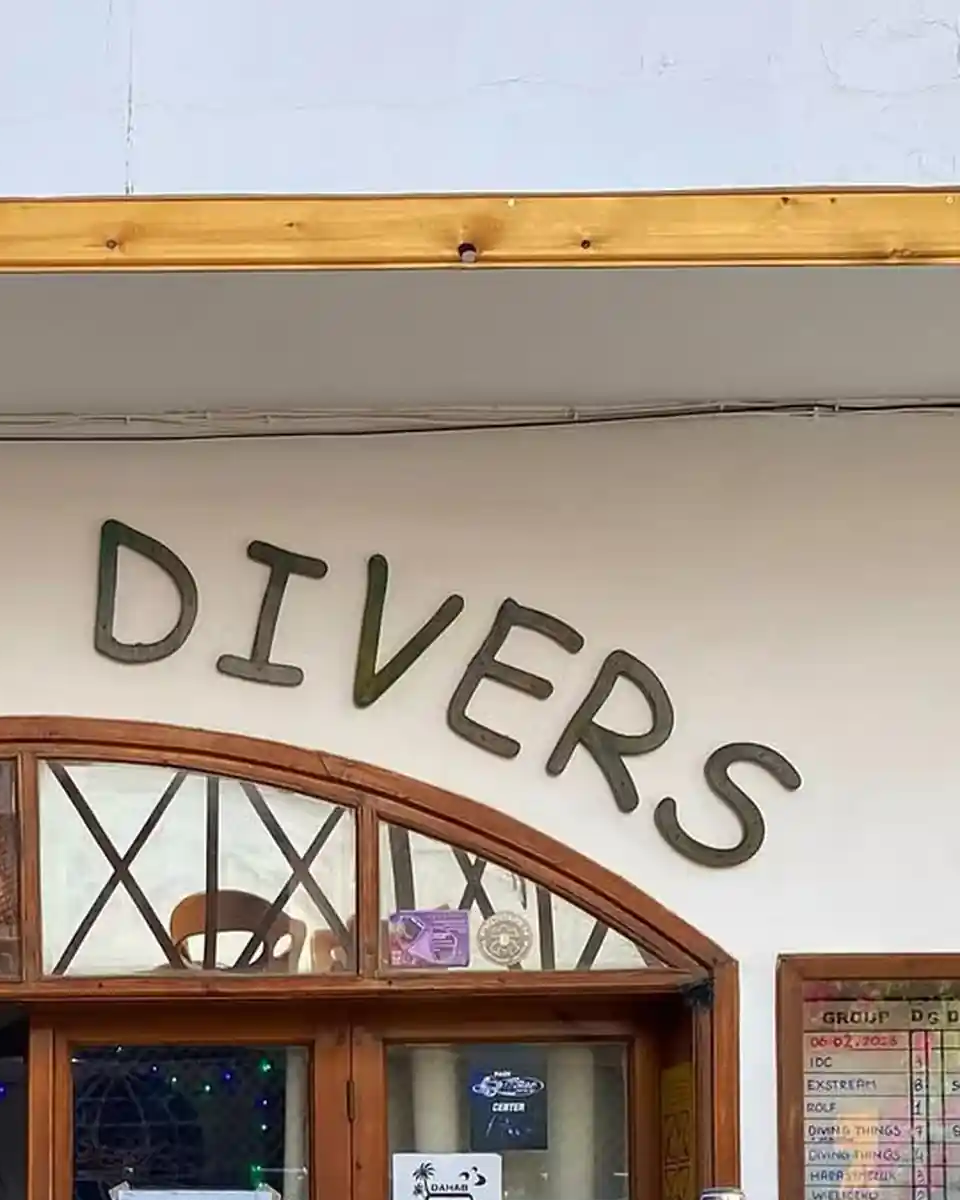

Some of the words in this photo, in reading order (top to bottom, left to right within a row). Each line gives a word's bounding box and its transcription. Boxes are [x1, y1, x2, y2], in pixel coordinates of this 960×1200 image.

[92, 519, 802, 869] DIVERS
[822, 1011, 890, 1025] GROUP
[810, 1056, 833, 1068] IDC
[807, 1079, 877, 1092] EXSTREAM
[808, 1127, 851, 1137] DIVING
[854, 1125, 902, 1137] THINGS
[852, 1150, 902, 1162] THINGS
[430, 1184, 469, 1192] DAHAB
